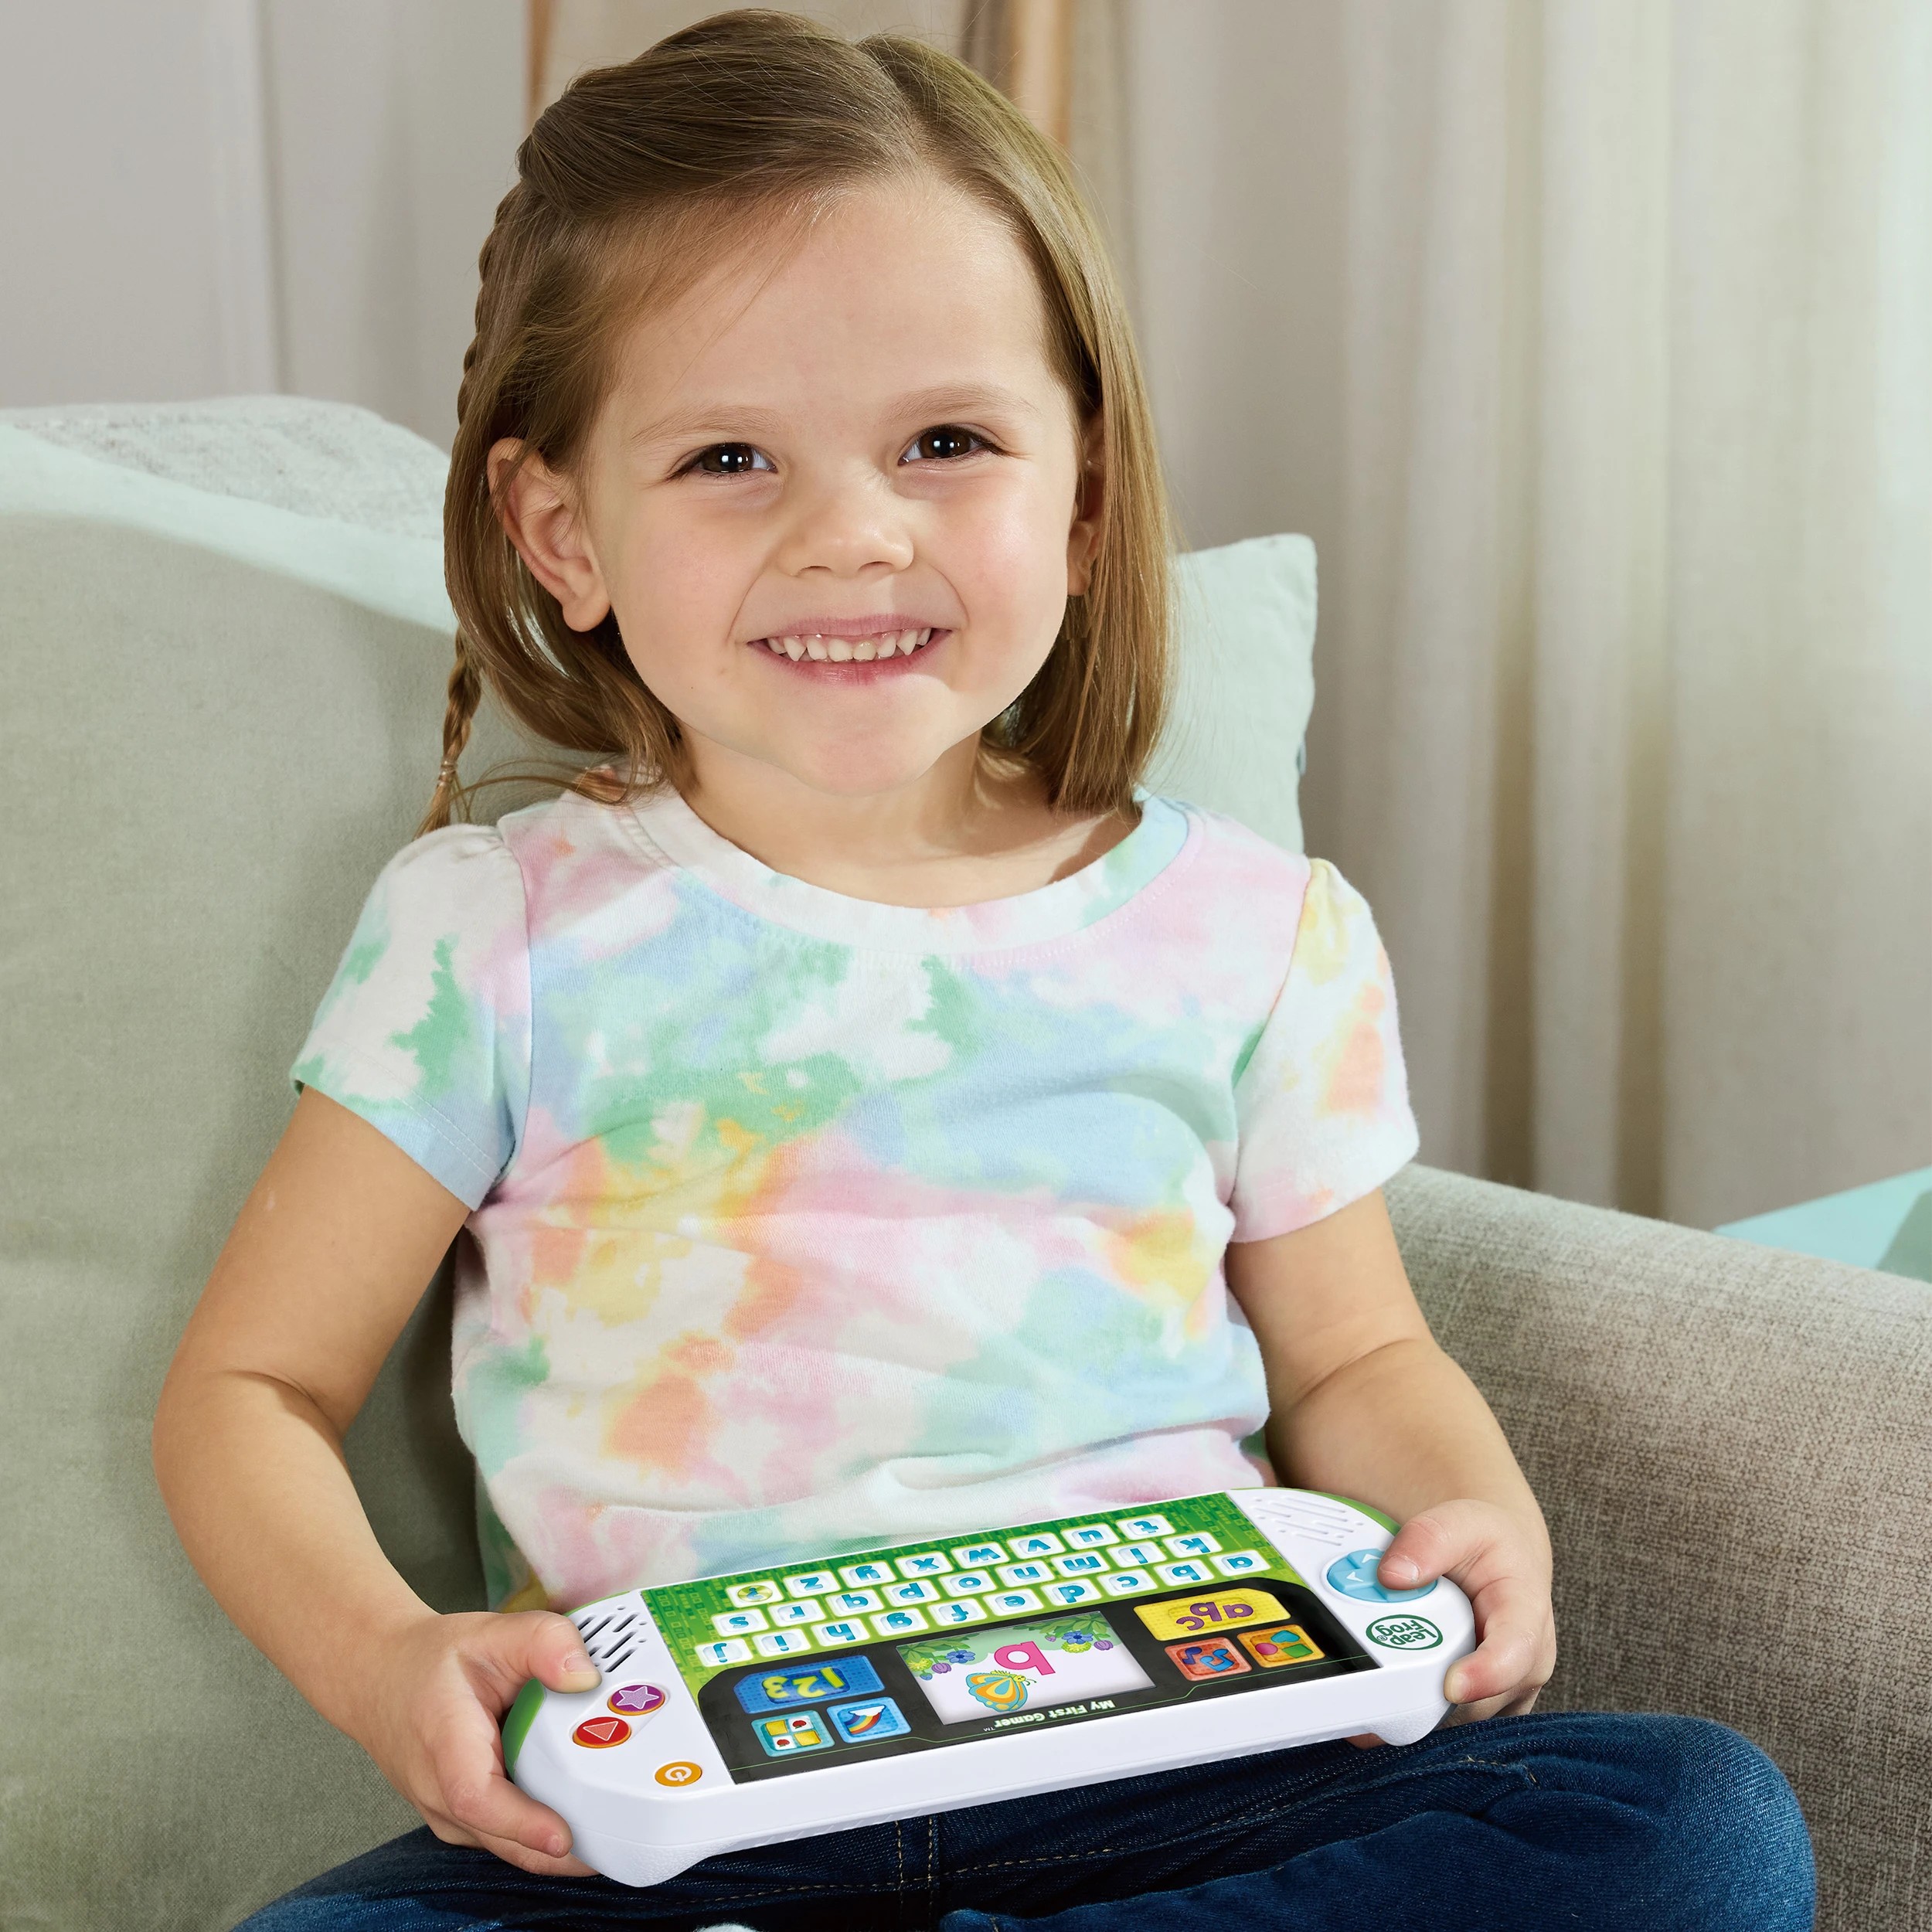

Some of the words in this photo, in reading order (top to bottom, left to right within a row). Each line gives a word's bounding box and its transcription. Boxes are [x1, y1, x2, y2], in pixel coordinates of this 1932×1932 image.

[1133, 1520, 1158, 1532] t
[1078, 1529, 1102, 1542] u
[1027, 1539, 1049, 1552] v
[1180, 1537, 1210, 1553] k
[968, 1547, 999, 1562] w
[912, 1557, 938, 1570] x
[1063, 1556, 1100, 1571] m
[1226, 1556, 1253, 1569] a
[855, 1565, 880, 1580] y
[1013, 1566, 1039, 1579] n
[1172, 1564, 1201, 1581] b
[799, 1577, 822, 1589] z
[899, 1582, 924, 1598] p
[842, 1594, 868, 1607] q
[1003, 1595, 1025, 1607] e
[1056, 1584, 1085, 1604] d
[790, 1606, 804, 1618] r
[885, 1612, 912, 1627] g
[951, 1604, 968, 1622] f
[1175, 1600, 1254, 1631] abc
[825, 1623, 855, 1641] h
[1389, 1628, 1437, 1645] Leap
[774, 1634, 788, 1651] i
[713, 1642, 726, 1662] j
[994, 1641, 1056, 1675] b
[761, 1666, 845, 1699] 123
[1047, 1704, 1089, 1719] First
[1090, 1699, 1116, 1711] My
